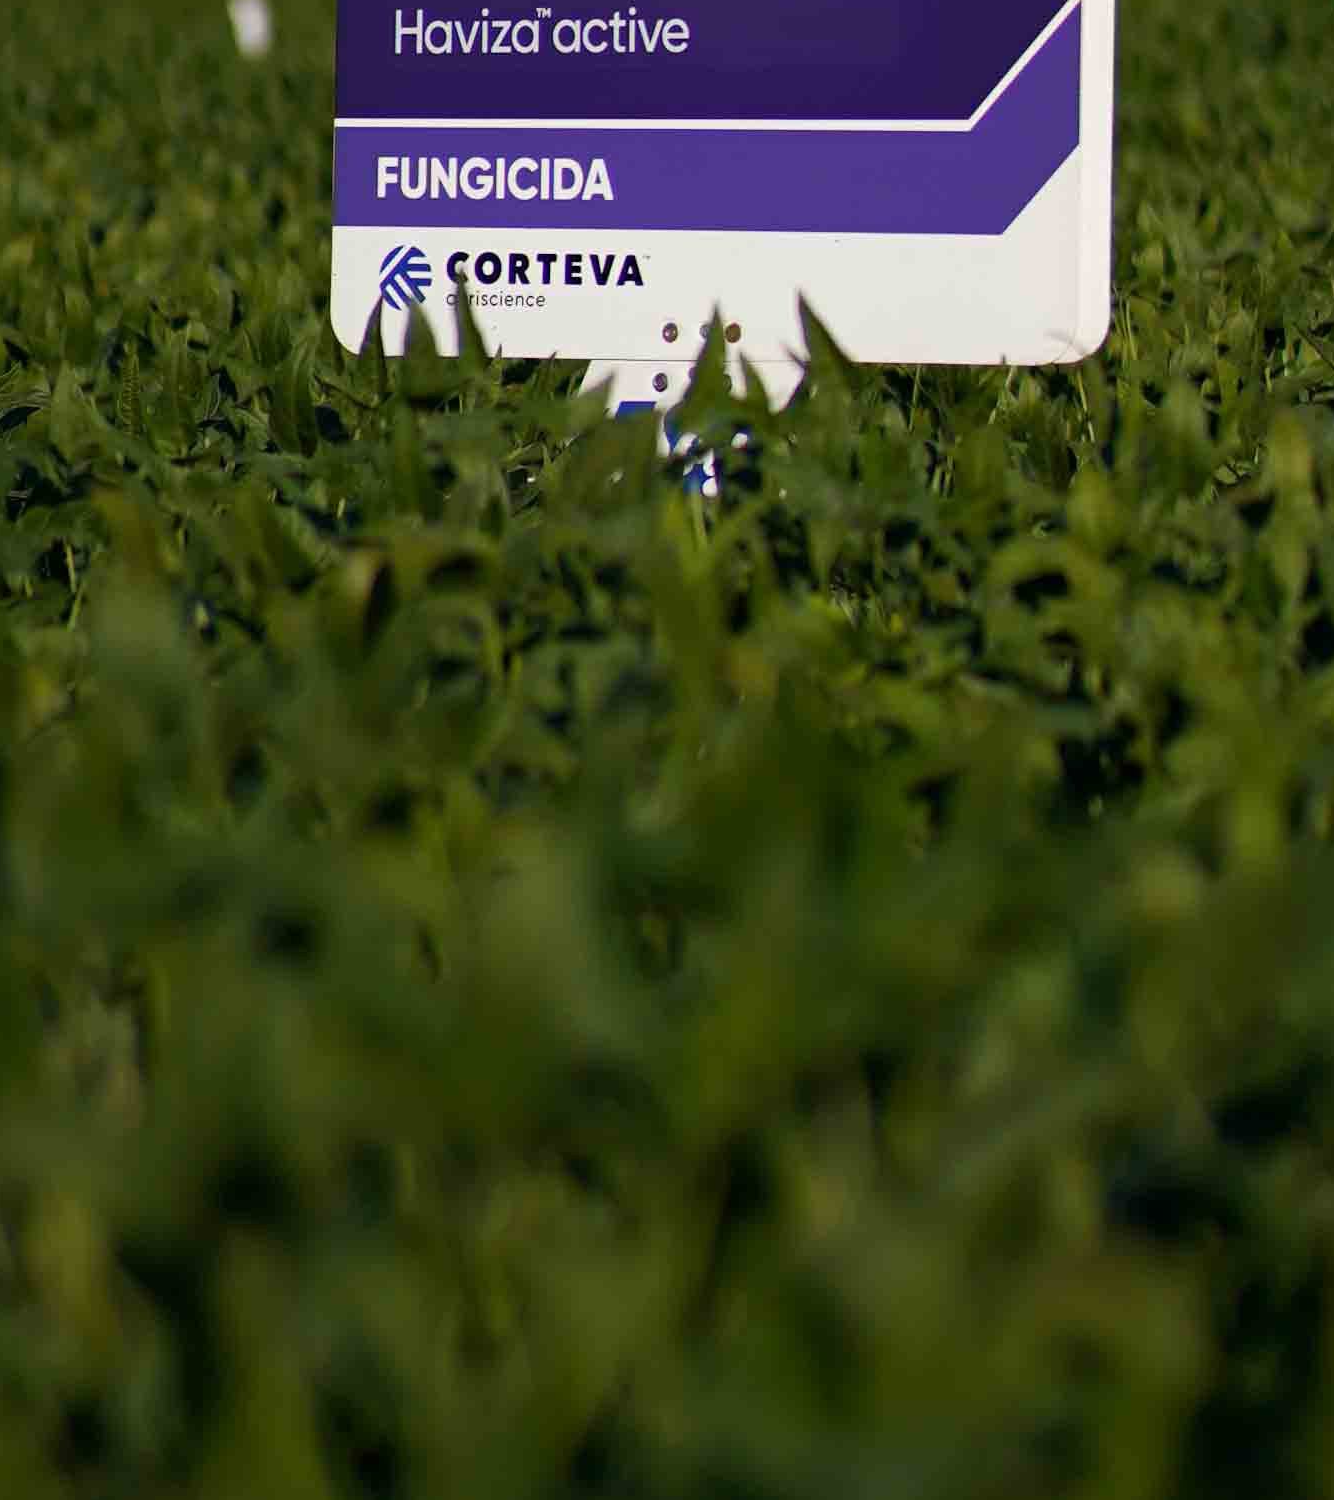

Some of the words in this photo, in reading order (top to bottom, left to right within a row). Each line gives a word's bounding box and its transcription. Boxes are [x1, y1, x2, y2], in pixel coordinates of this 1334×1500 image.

[552, 6, 691, 54] active
[377, 156, 614, 201] FUNGICIDA
[446, 290, 547, 307] ariscience
